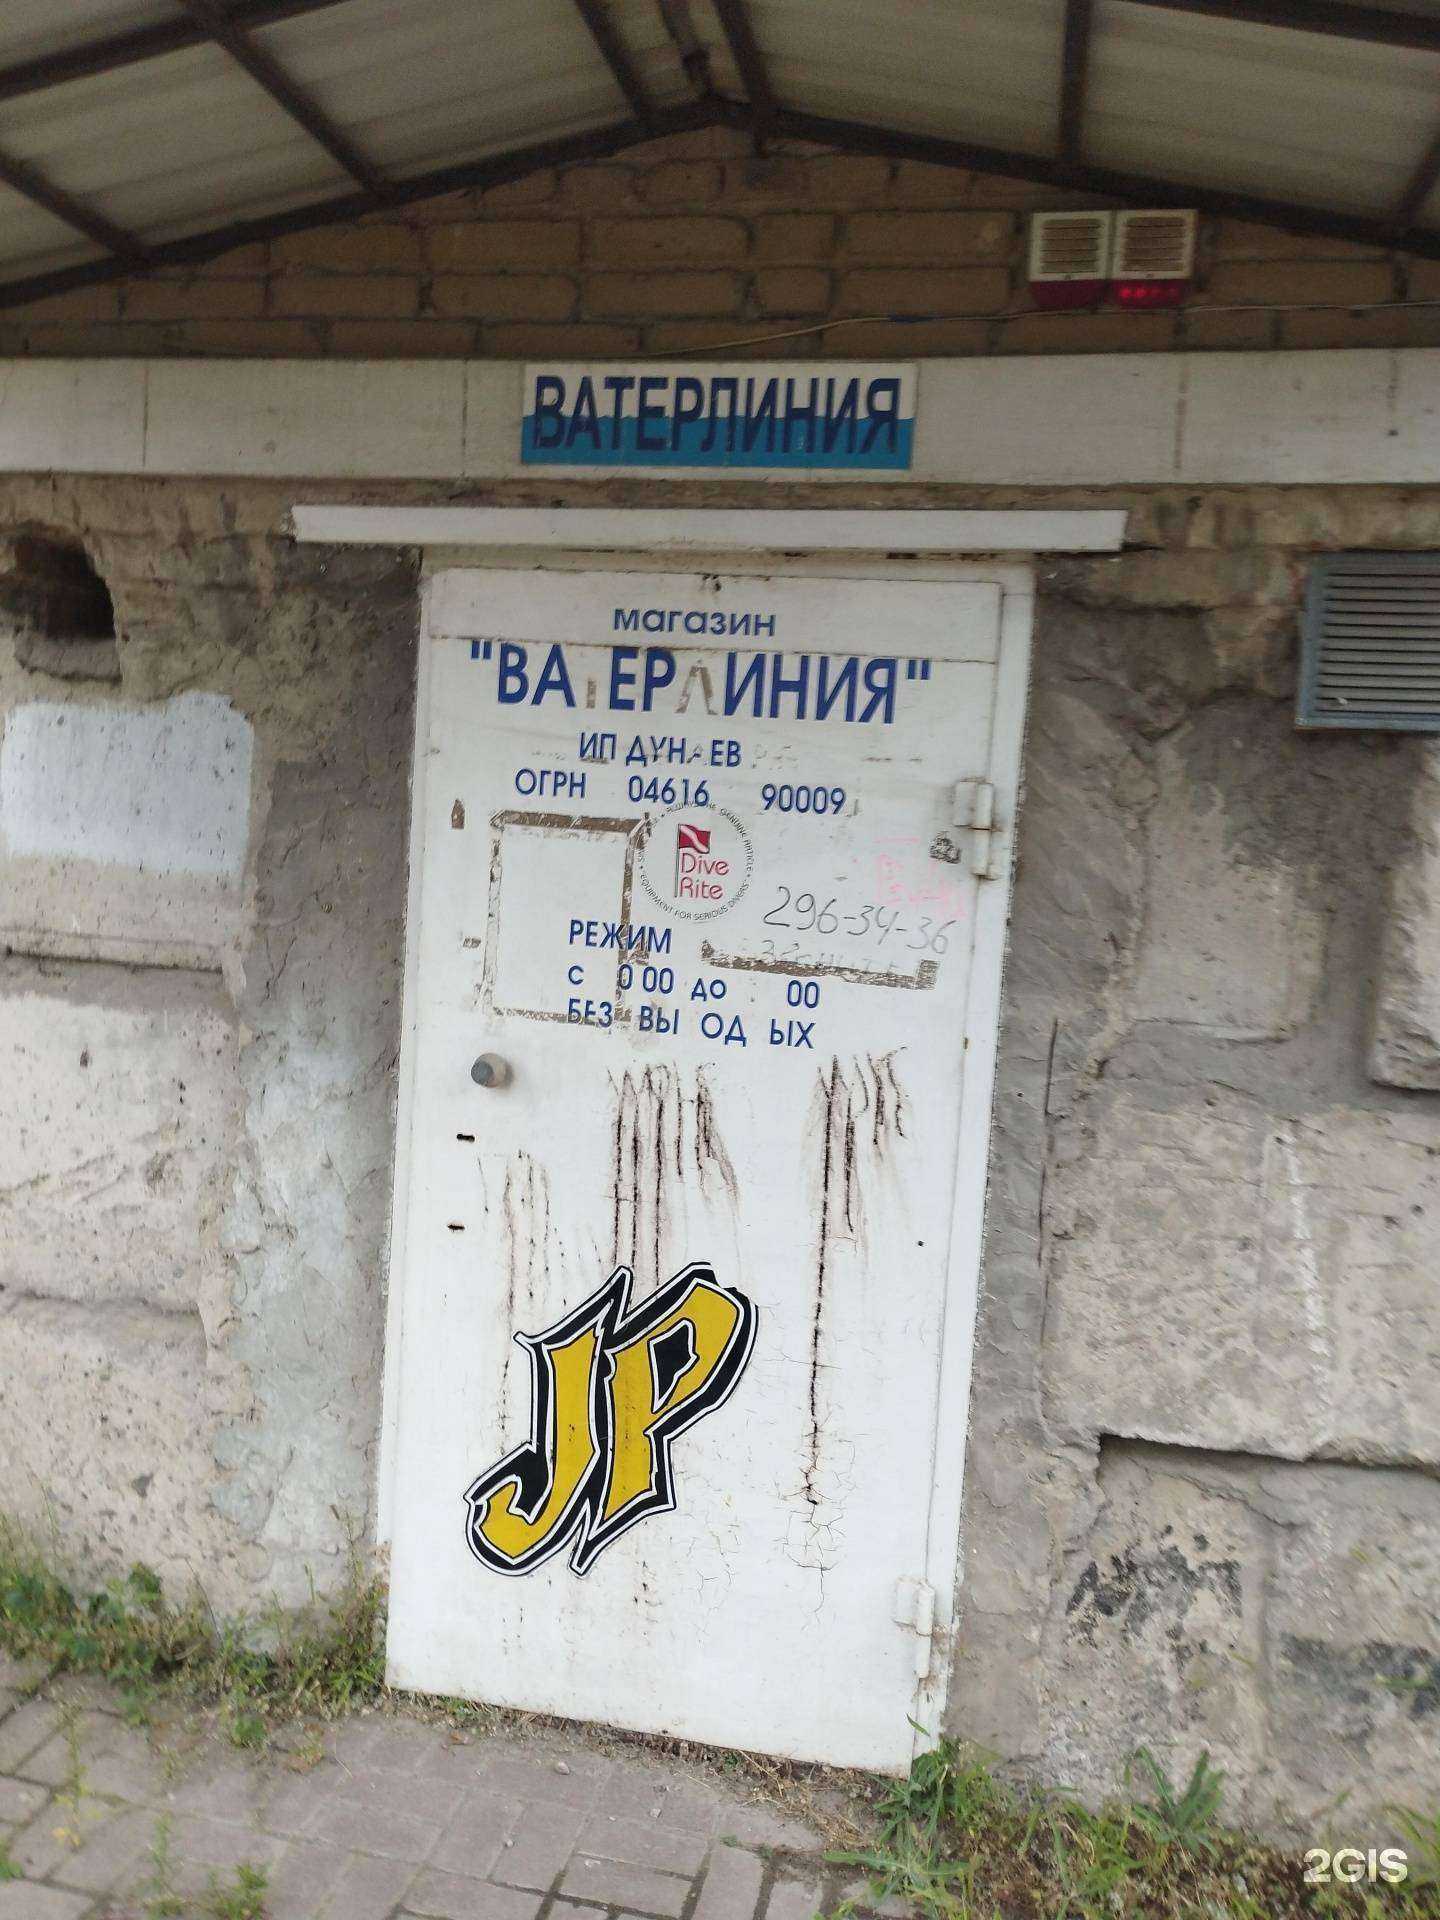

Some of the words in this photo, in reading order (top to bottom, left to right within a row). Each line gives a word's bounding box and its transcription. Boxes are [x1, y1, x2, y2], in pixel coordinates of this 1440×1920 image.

[533, 375, 902, 455] ВАТЕРЛИНИЯ
[613, 608, 777, 637] магазин
[579, 731, 617, 760] ИП
[515, 768, 587, 798] ОГРН
[681, 852, 729, 876] Dive
[680, 876, 724, 900] Rite
[763, 886, 957, 955] 296-34-36
[569, 919, 672, 954] РЕЖИМ
[568, 997, 614, 1028] БЕЗ
